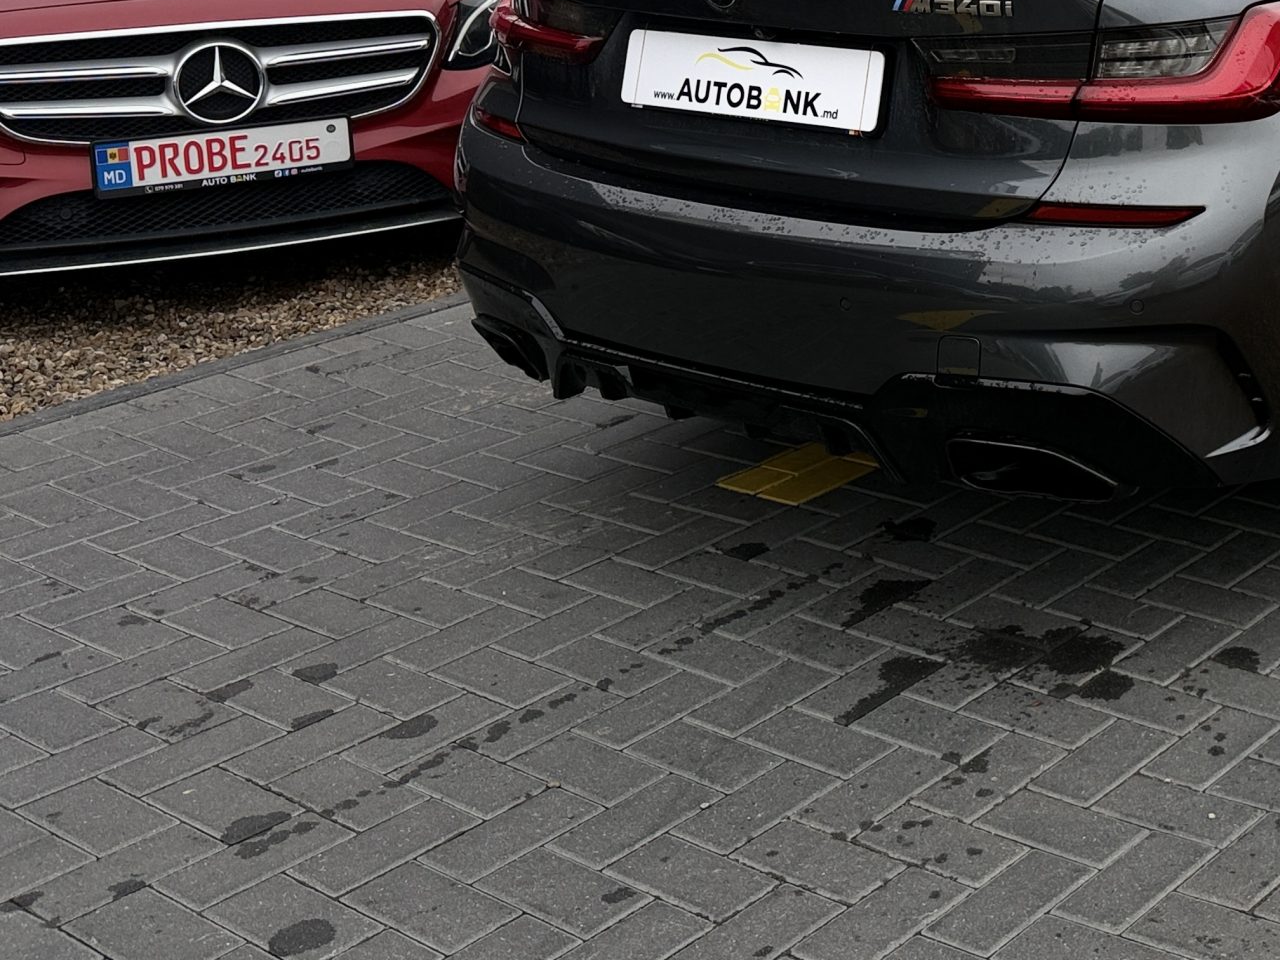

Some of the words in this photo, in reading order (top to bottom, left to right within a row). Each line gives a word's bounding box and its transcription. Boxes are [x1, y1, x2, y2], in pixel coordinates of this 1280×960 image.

[133, 134, 251, 181] PROBE
[254, 138, 321, 168] 2405
[103, 169, 127, 185] MD
[202, 176, 228, 187] AUTO
